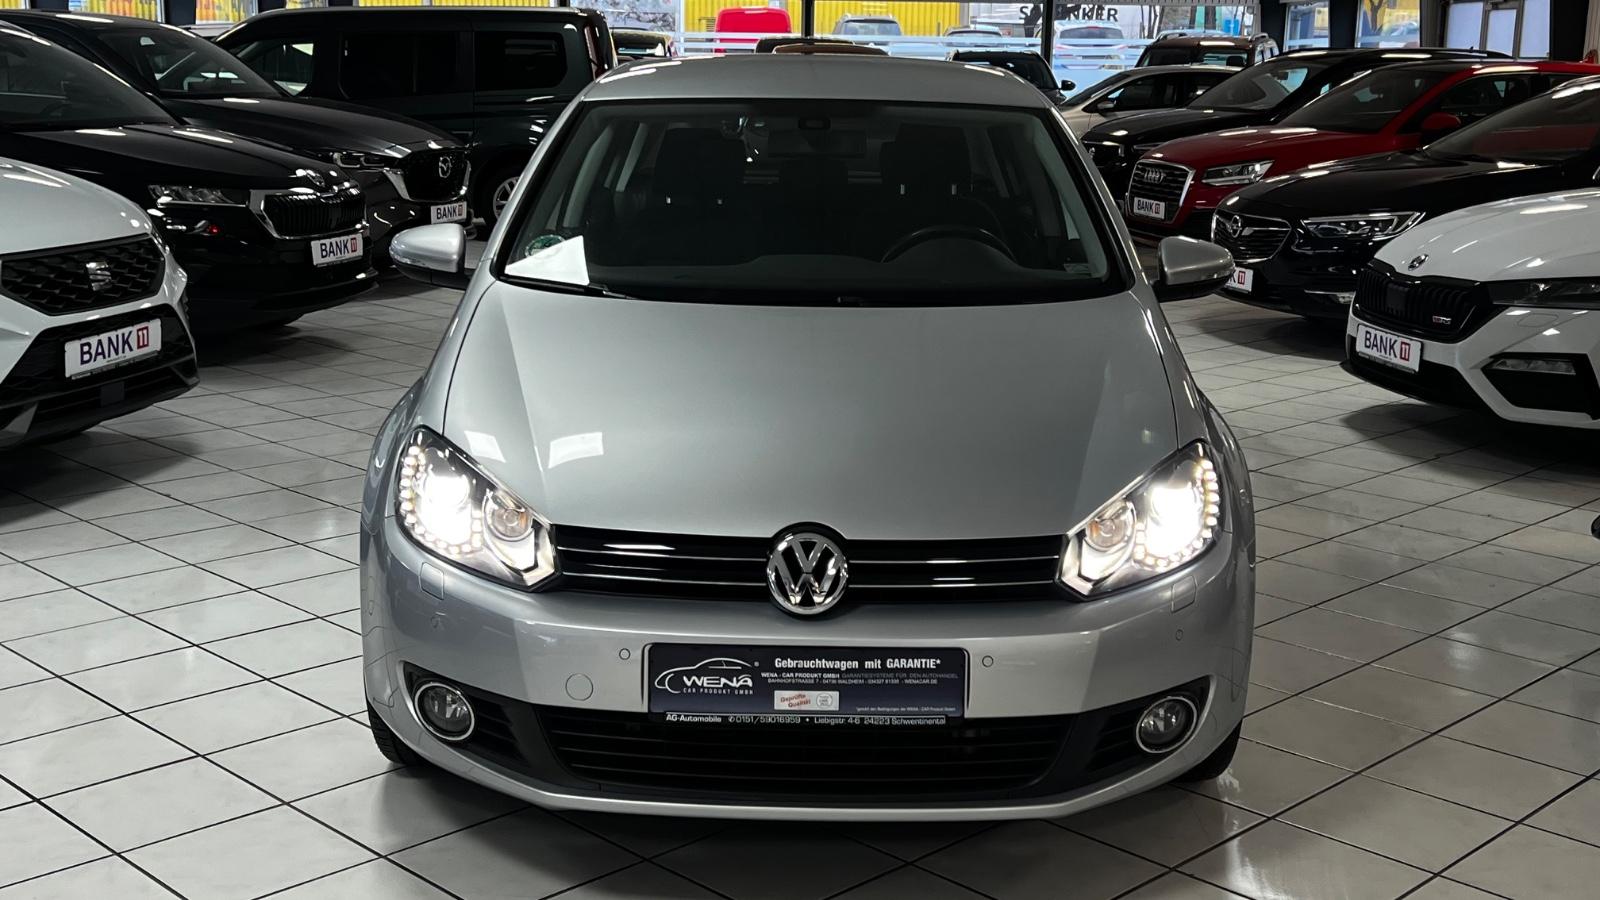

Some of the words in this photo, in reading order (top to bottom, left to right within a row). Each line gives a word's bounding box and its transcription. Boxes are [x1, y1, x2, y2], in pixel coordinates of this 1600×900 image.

[437, 205, 457, 219] BANK
[320, 239, 349, 258] BANK
[80, 331, 133, 365] BANK
[137, 326, 149, 349] 11
[1365, 331, 1398, 358] BANK
[1400, 341, 1411, 361] 11
[775, 658, 858, 670] Gebrauchtwagen
[865, 659, 881, 669] mit
[666, 714, 722, 723] AG-Automobile
